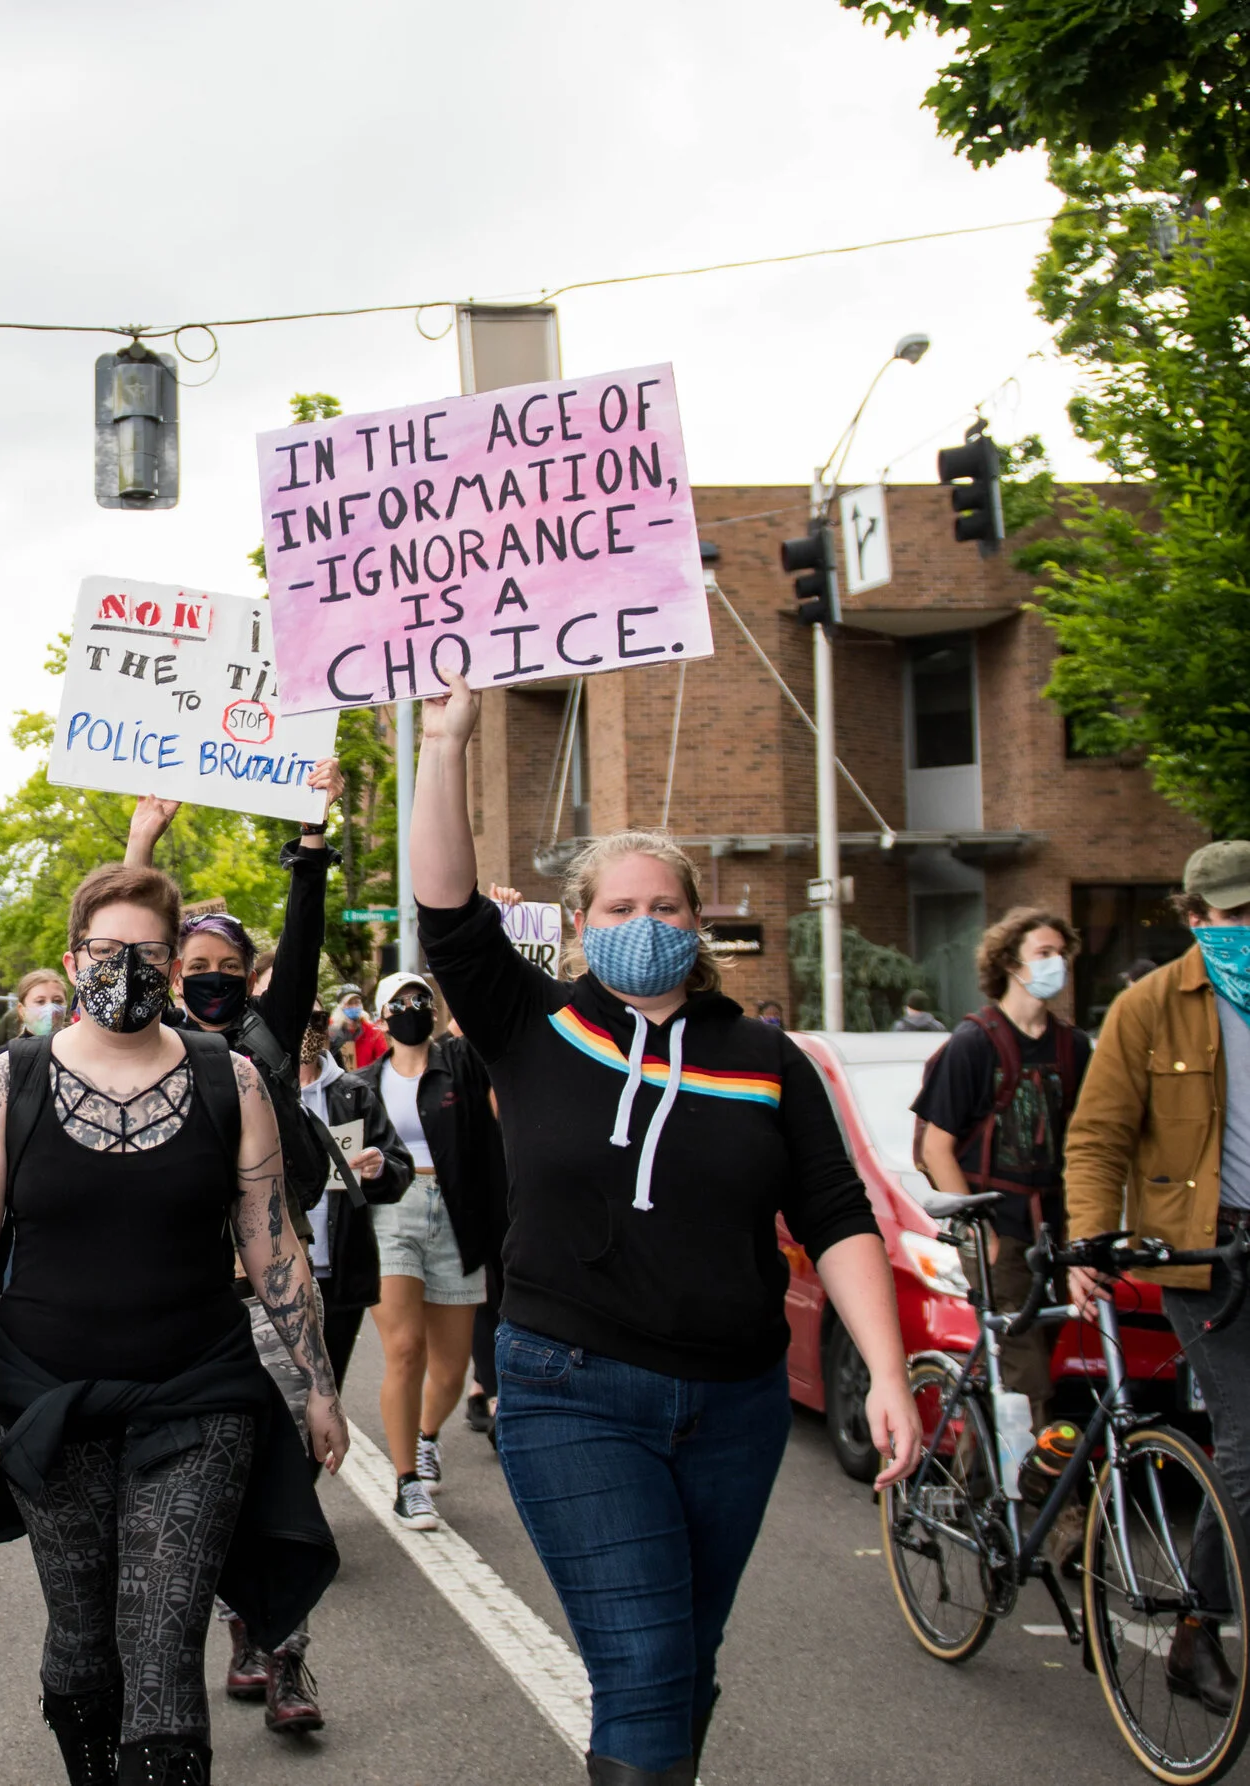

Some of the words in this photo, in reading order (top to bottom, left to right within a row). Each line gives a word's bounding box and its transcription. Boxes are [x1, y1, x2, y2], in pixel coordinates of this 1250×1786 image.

[275, 436, 335, 492] IN
[356, 411, 449, 471] THE
[486, 390, 582, 453] AGE
[598, 379, 661, 433] OF
[271, 442, 678, 552] INFORMATION,
[400, 584, 465, 631] IS
[494, 577, 529, 617] A
[86, 644, 178, 686] THE
[327, 606, 685, 702] CHOICE.
[171, 689, 201, 714] TO
[229, 707, 269, 730] STOP
[495, 902, 560, 942] RONG
